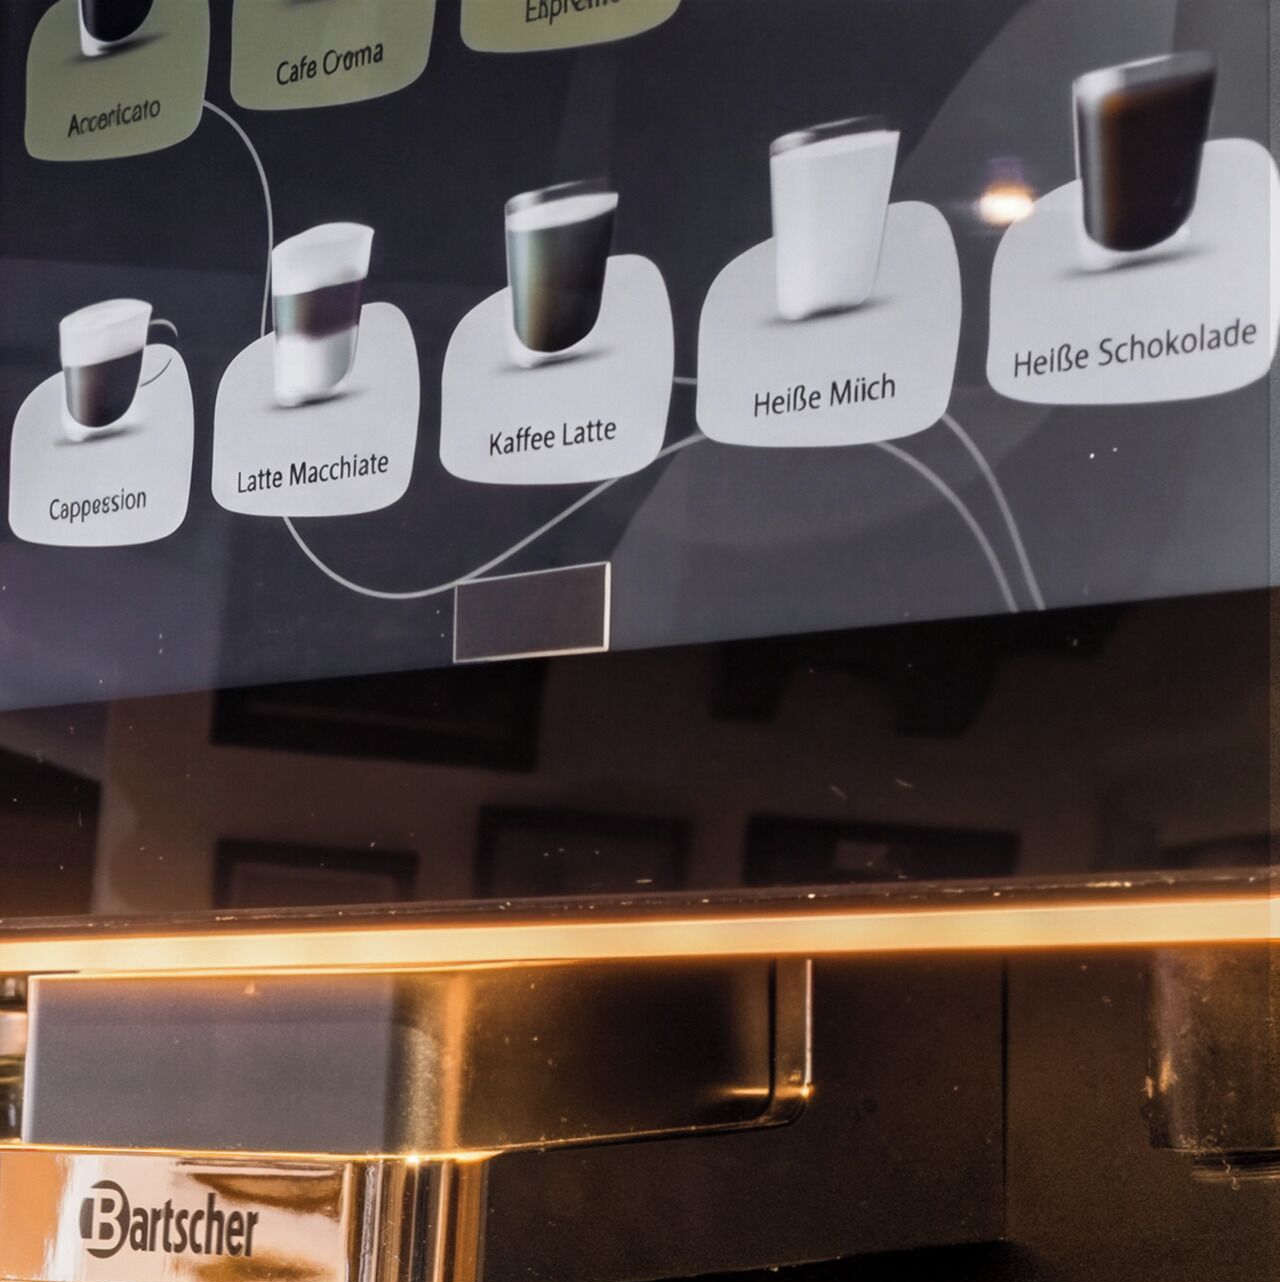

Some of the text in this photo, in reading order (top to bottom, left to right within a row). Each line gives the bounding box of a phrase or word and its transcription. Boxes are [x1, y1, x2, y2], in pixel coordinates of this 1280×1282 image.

[1014, 317, 1258, 378] Heiße Schokolade
[753, 383, 822, 418] Heiße
[489, 418, 617, 456] Kaffee Latte
[237, 468, 283, 494] Latte
[79, 1180, 260, 1259] Bartscher
